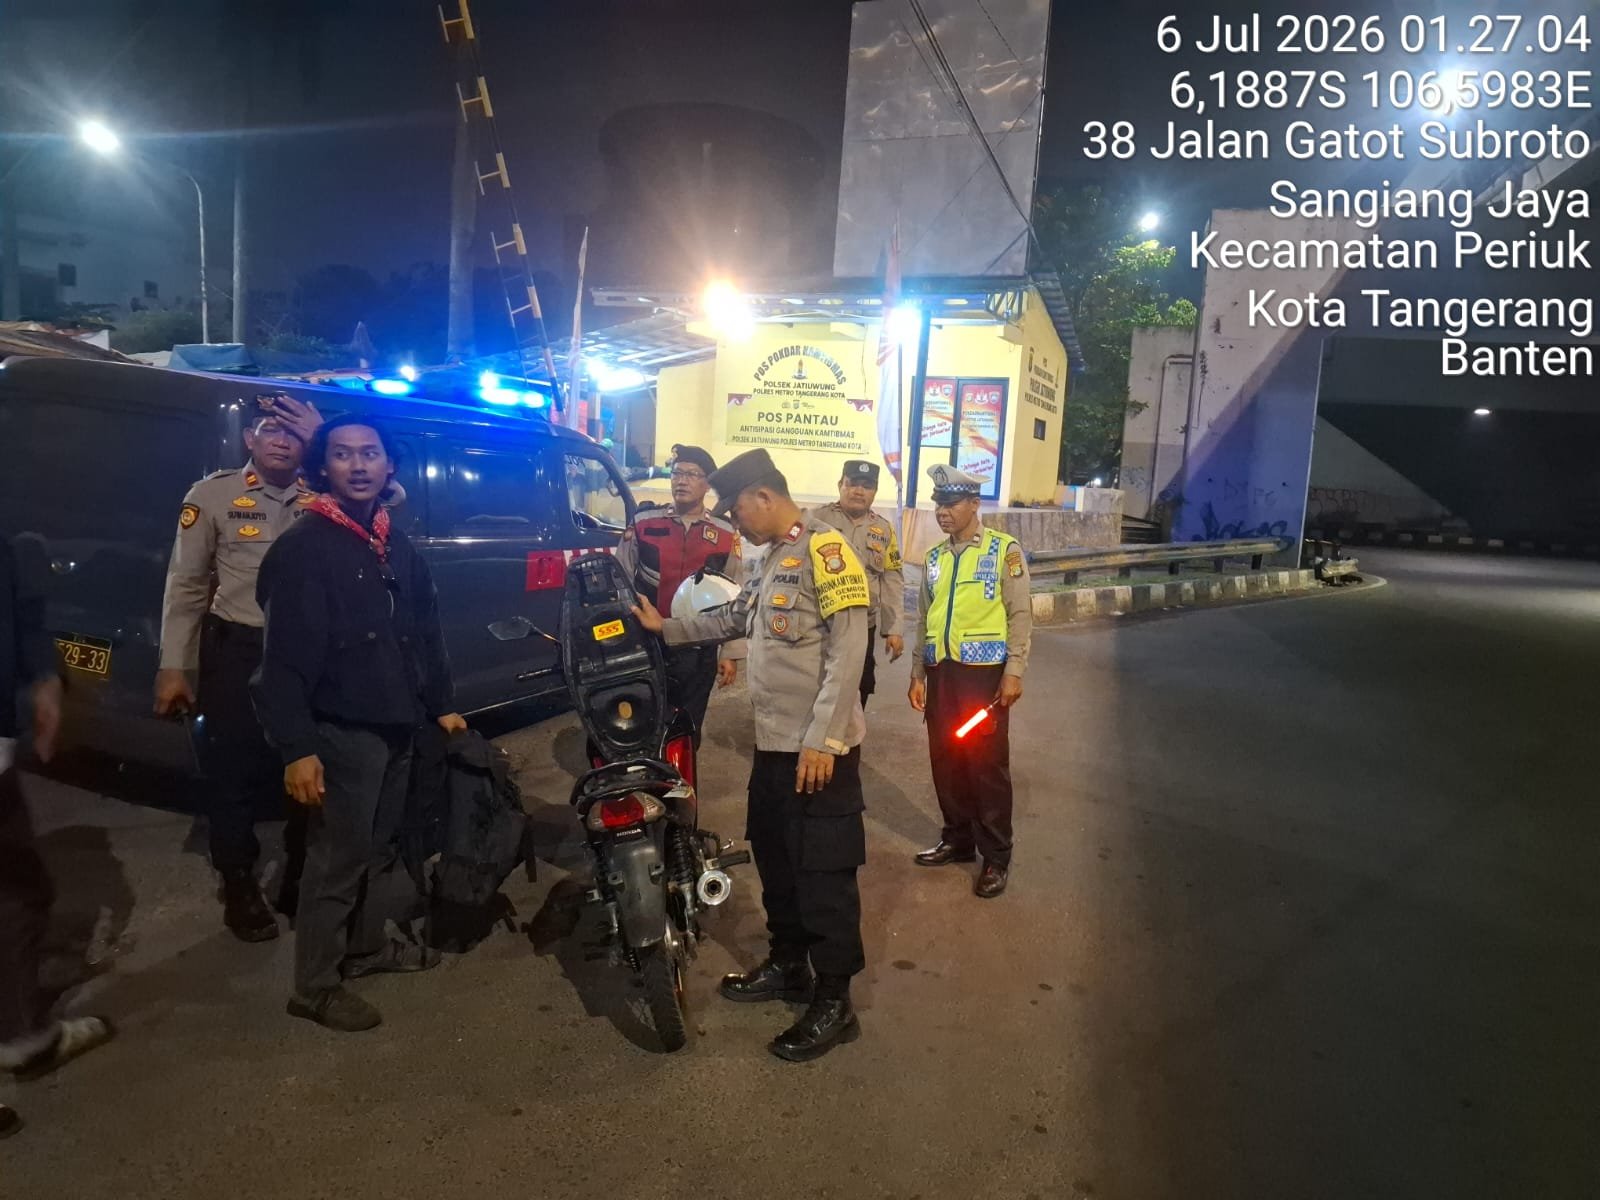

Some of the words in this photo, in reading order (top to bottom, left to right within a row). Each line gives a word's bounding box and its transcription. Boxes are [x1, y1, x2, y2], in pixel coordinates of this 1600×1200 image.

[754, 361, 770, 381] POS
[767, 345, 801, 366] POKDAR
[763, 380, 791, 389] POLSEK
[793, 382, 836, 391] JATIUWUNG
[795, 390, 829, 398] TANGERANG
[757, 411, 783, 423] POS
[786, 412, 839, 426] PANTAU
[740, 425, 775, 433] ANTISIPASI
[775, 426, 814, 436] GANGGUAN
[815, 429, 855, 438] KAMTIBMAS
[773, 574, 800, 585] POLRI
[59, 642, 107, 670] 29-33
